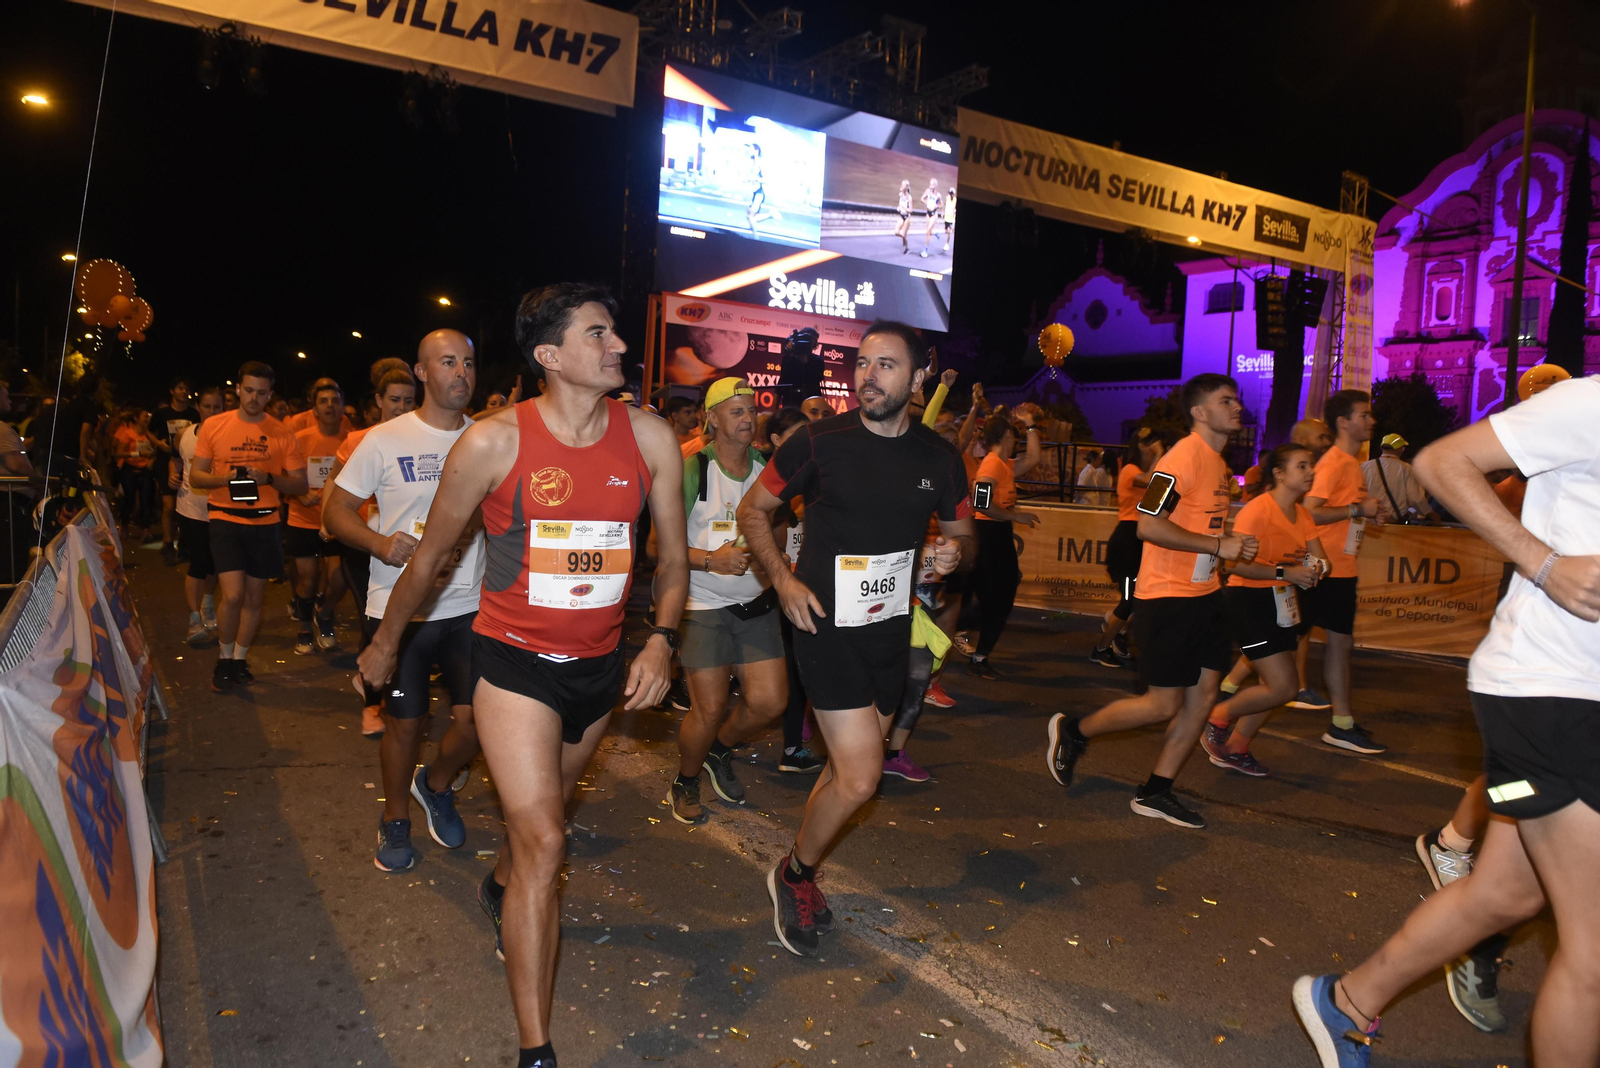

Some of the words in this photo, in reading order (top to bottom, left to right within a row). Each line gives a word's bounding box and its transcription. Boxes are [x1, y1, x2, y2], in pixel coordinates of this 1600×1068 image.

[962, 134, 1101, 195] NOCTURNA
[1105, 173, 1196, 218] SEVILLA
[718, 312, 733, 320] ABC
[740, 316, 771, 328] Cruzcampo
[567, 552, 603, 573] 999
[1057, 537, 1109, 566] IMD
[1387, 556, 1461, 585] IMD
[860, 576, 896, 597] 9468
[1035, 575, 1078, 587] Instituto
[1051, 587, 1064, 596] de
[1360, 596, 1410, 605] Instituto
[1414, 596, 1478, 612] Municipal
[1375, 607, 1392, 617] de
[1396, 608, 1455, 623] Deportes
